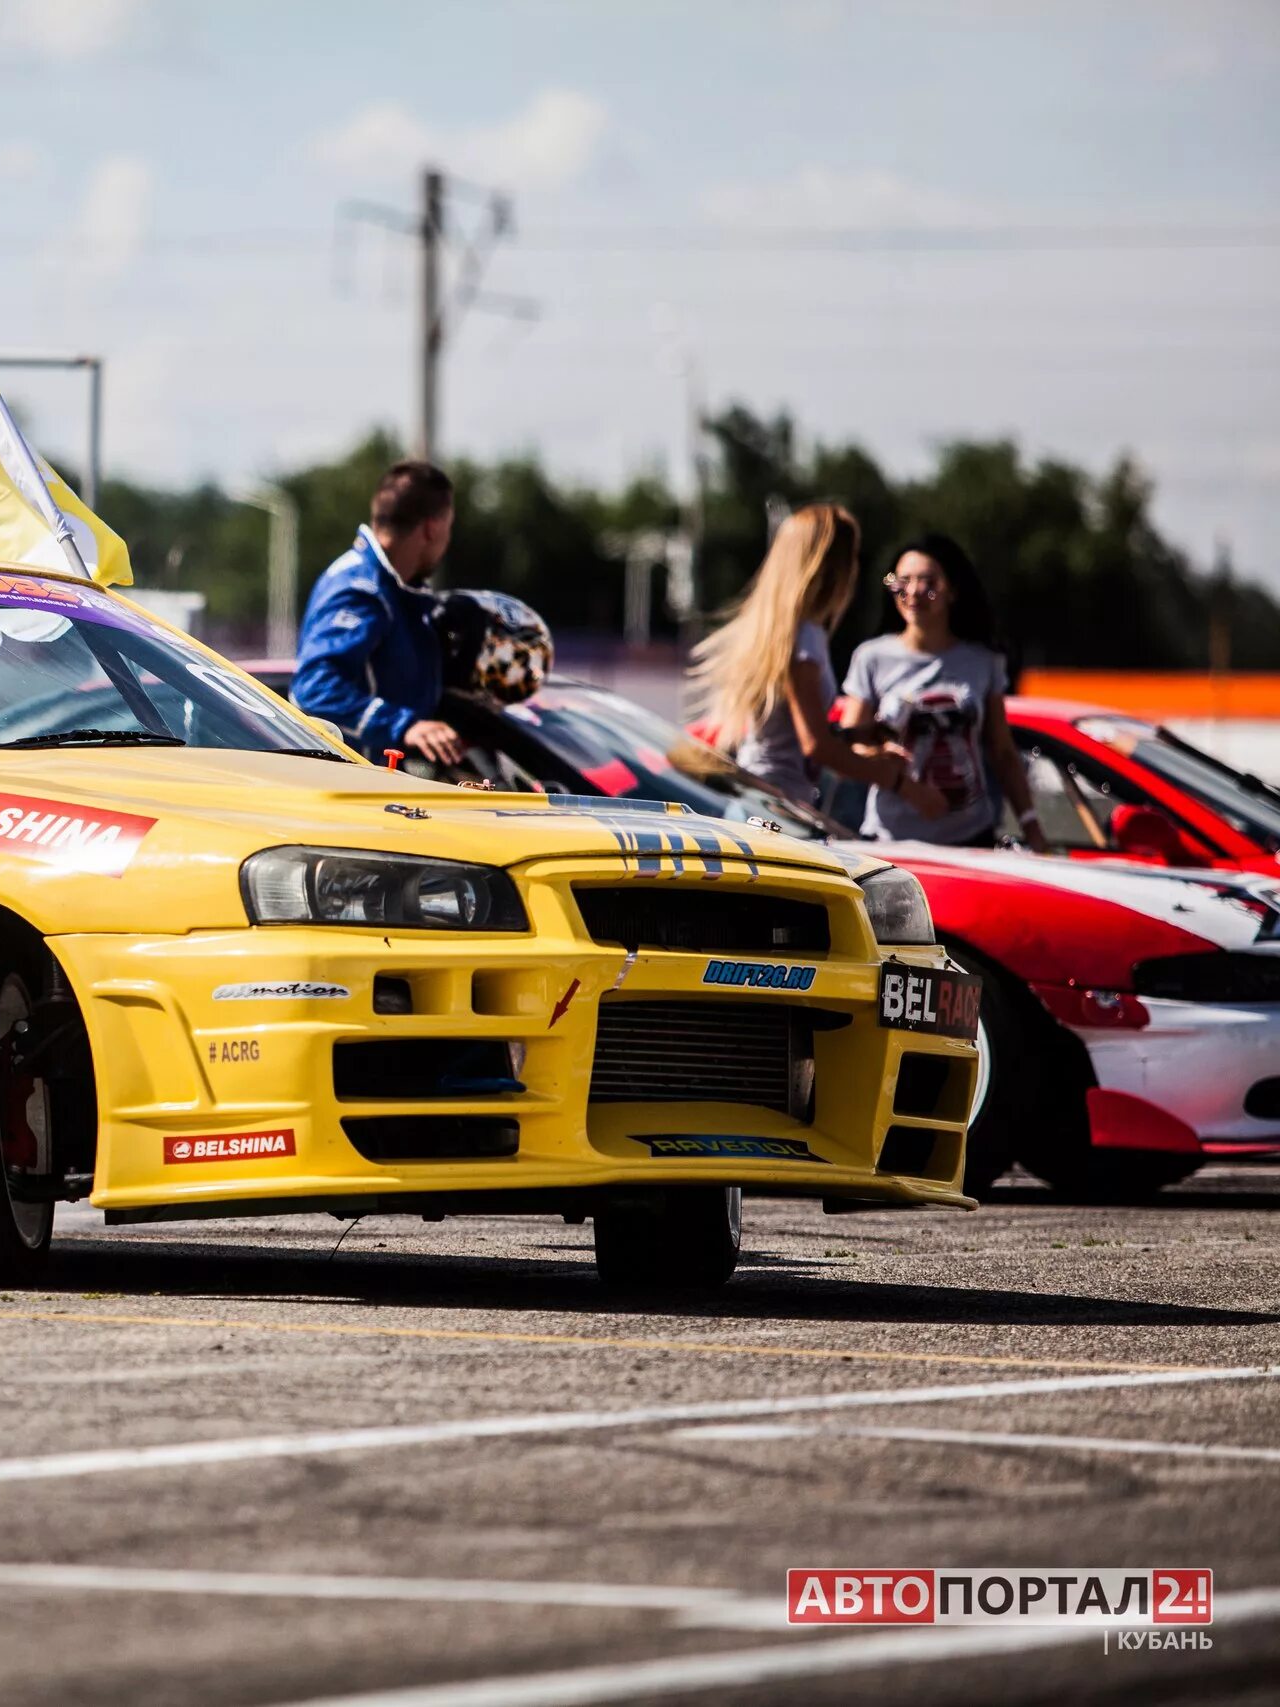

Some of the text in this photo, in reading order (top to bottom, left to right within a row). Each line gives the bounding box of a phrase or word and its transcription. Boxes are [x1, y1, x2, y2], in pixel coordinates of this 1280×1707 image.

[703, 960, 816, 990] DRIFT26.RU
[883, 973, 937, 1022] BEL
[222, 1040, 260, 1063] ACRG
[193, 1135, 286, 1157] BELSHINA
[652, 1140, 810, 1157] RAVENOL
